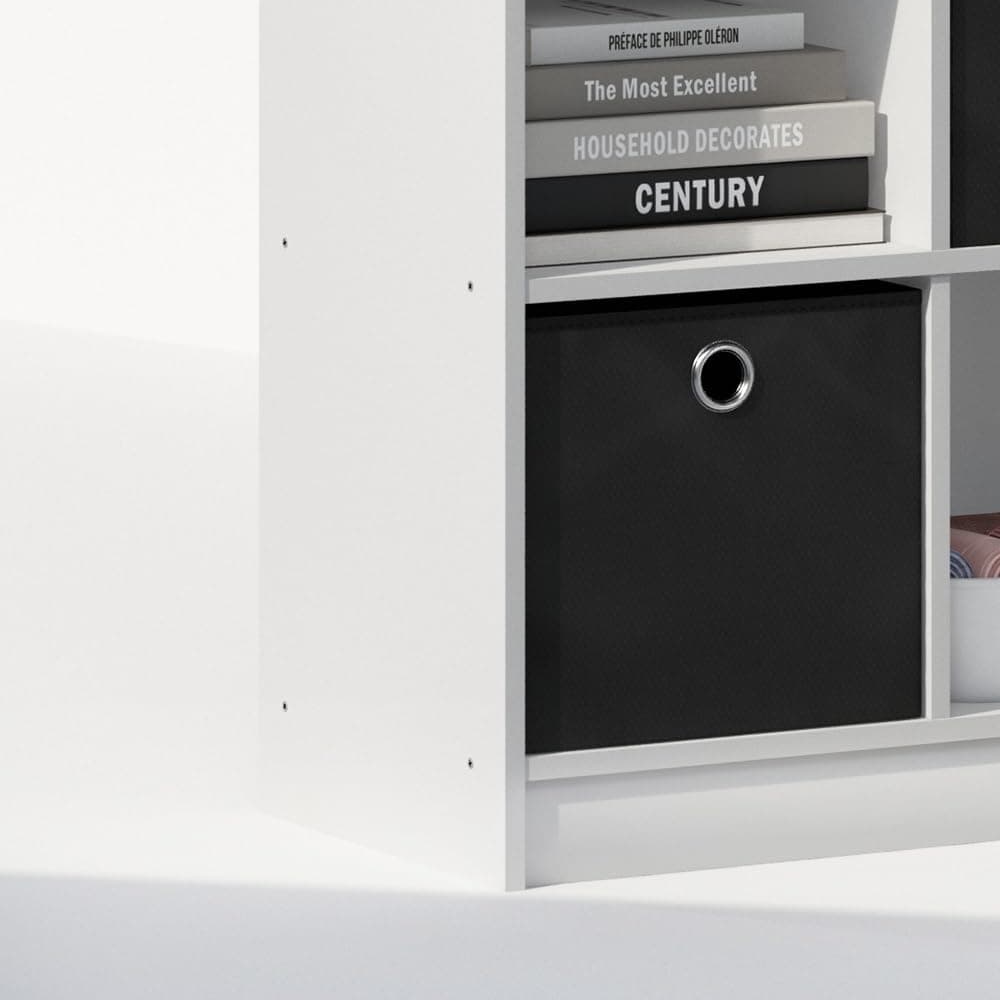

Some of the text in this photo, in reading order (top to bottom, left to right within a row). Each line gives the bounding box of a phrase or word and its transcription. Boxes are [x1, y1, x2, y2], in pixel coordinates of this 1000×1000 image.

[608, 26, 740, 50] PRÉFACE DE PHILIPPE OLÉRON
[585, 71, 757, 101] The Most Excellent
[573, 122, 804, 160] HOUSEHOLD DECORATES
[635, 175, 765, 214] CENTURY
